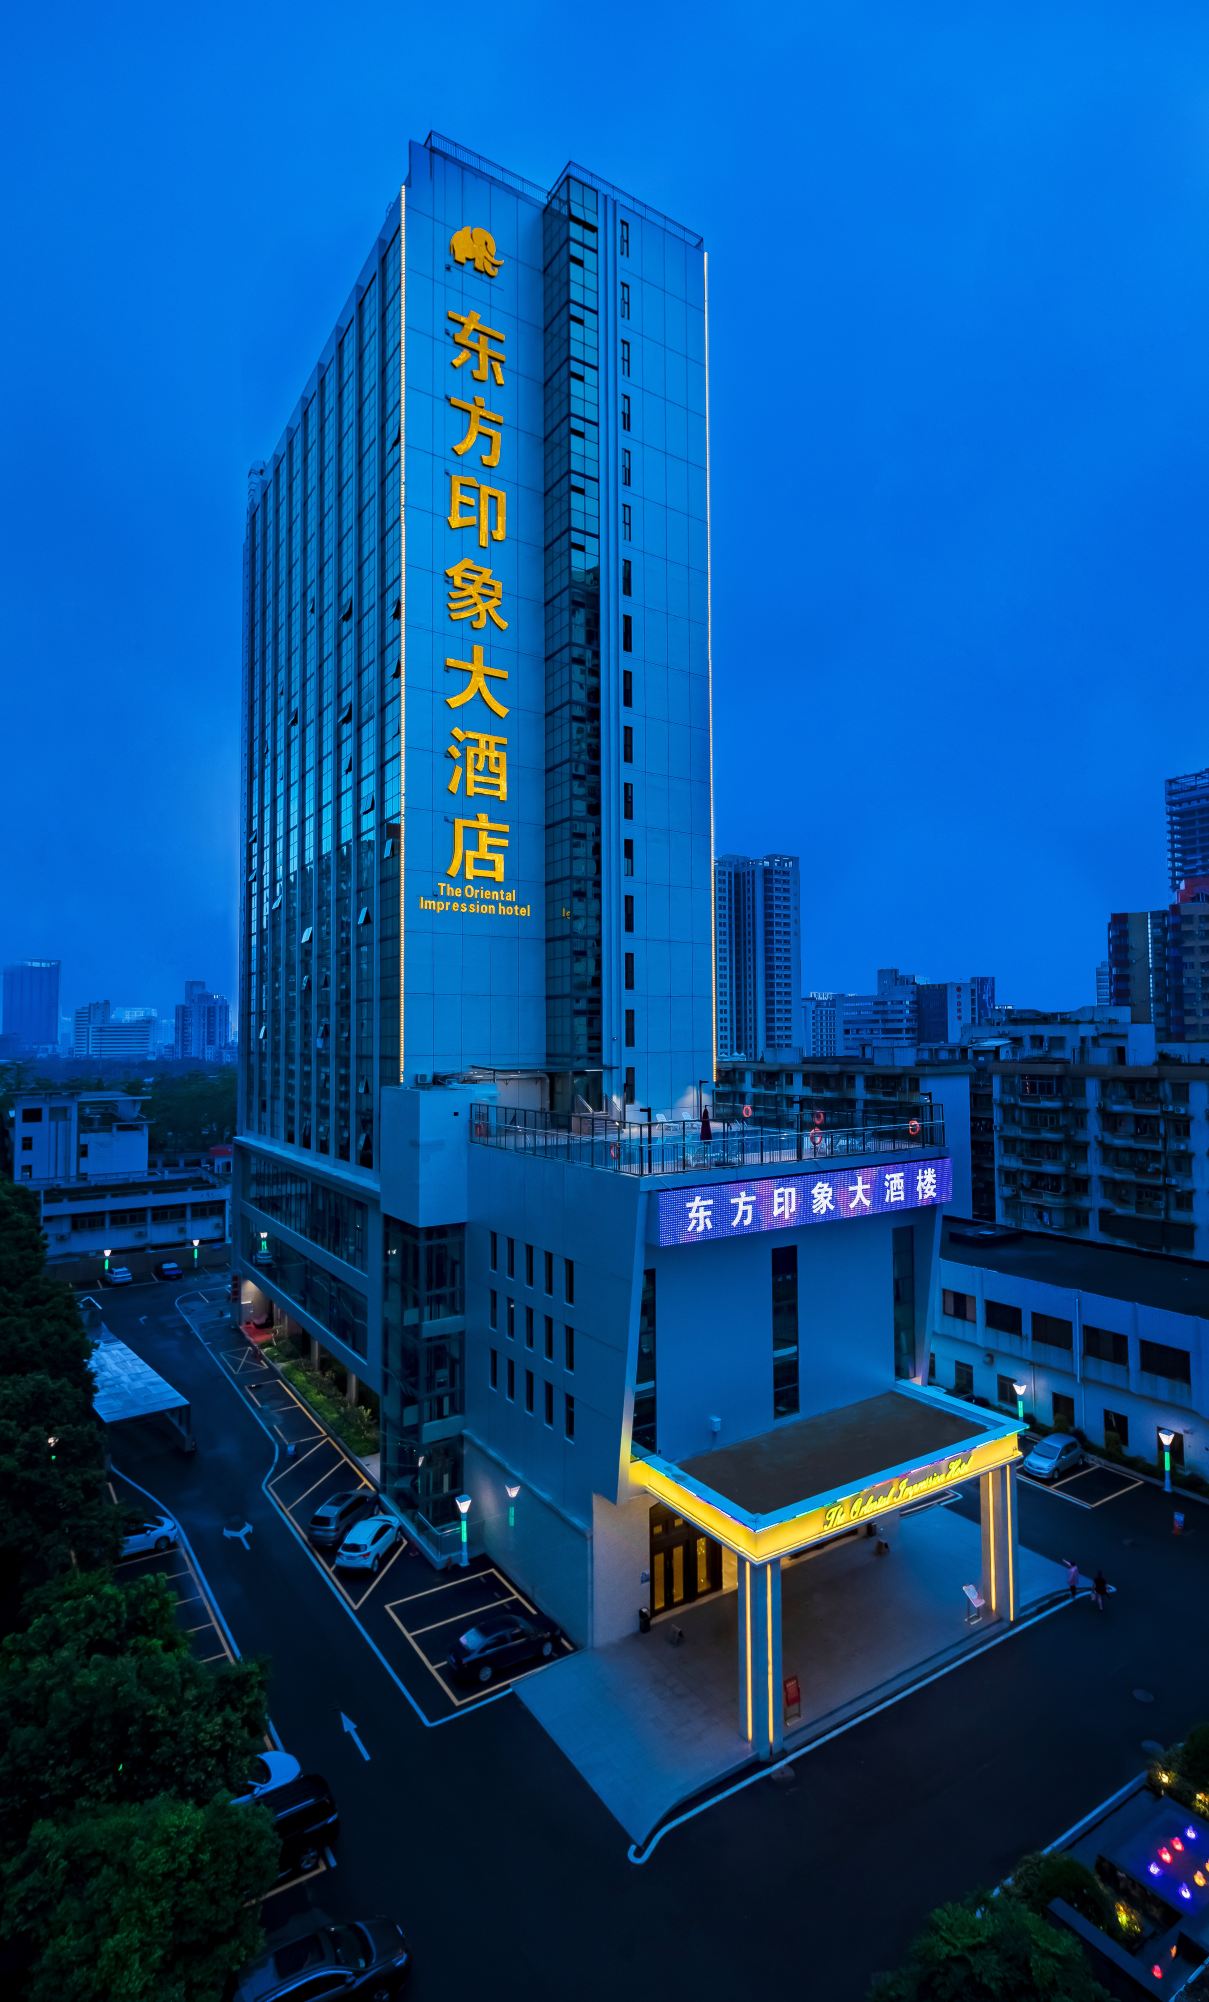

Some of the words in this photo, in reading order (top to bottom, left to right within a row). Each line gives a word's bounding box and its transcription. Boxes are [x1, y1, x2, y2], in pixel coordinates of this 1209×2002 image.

[446, 310, 510, 882] 东方印象大酒店
[437, 883, 462, 897] The
[464, 885, 516, 901] Oriental
[419, 897, 496, 913] Impression
[498, 904, 531, 917] hotel
[685, 1167, 938, 1233] 东方印象大酒楼
[823, 1504, 846, 1531] The
